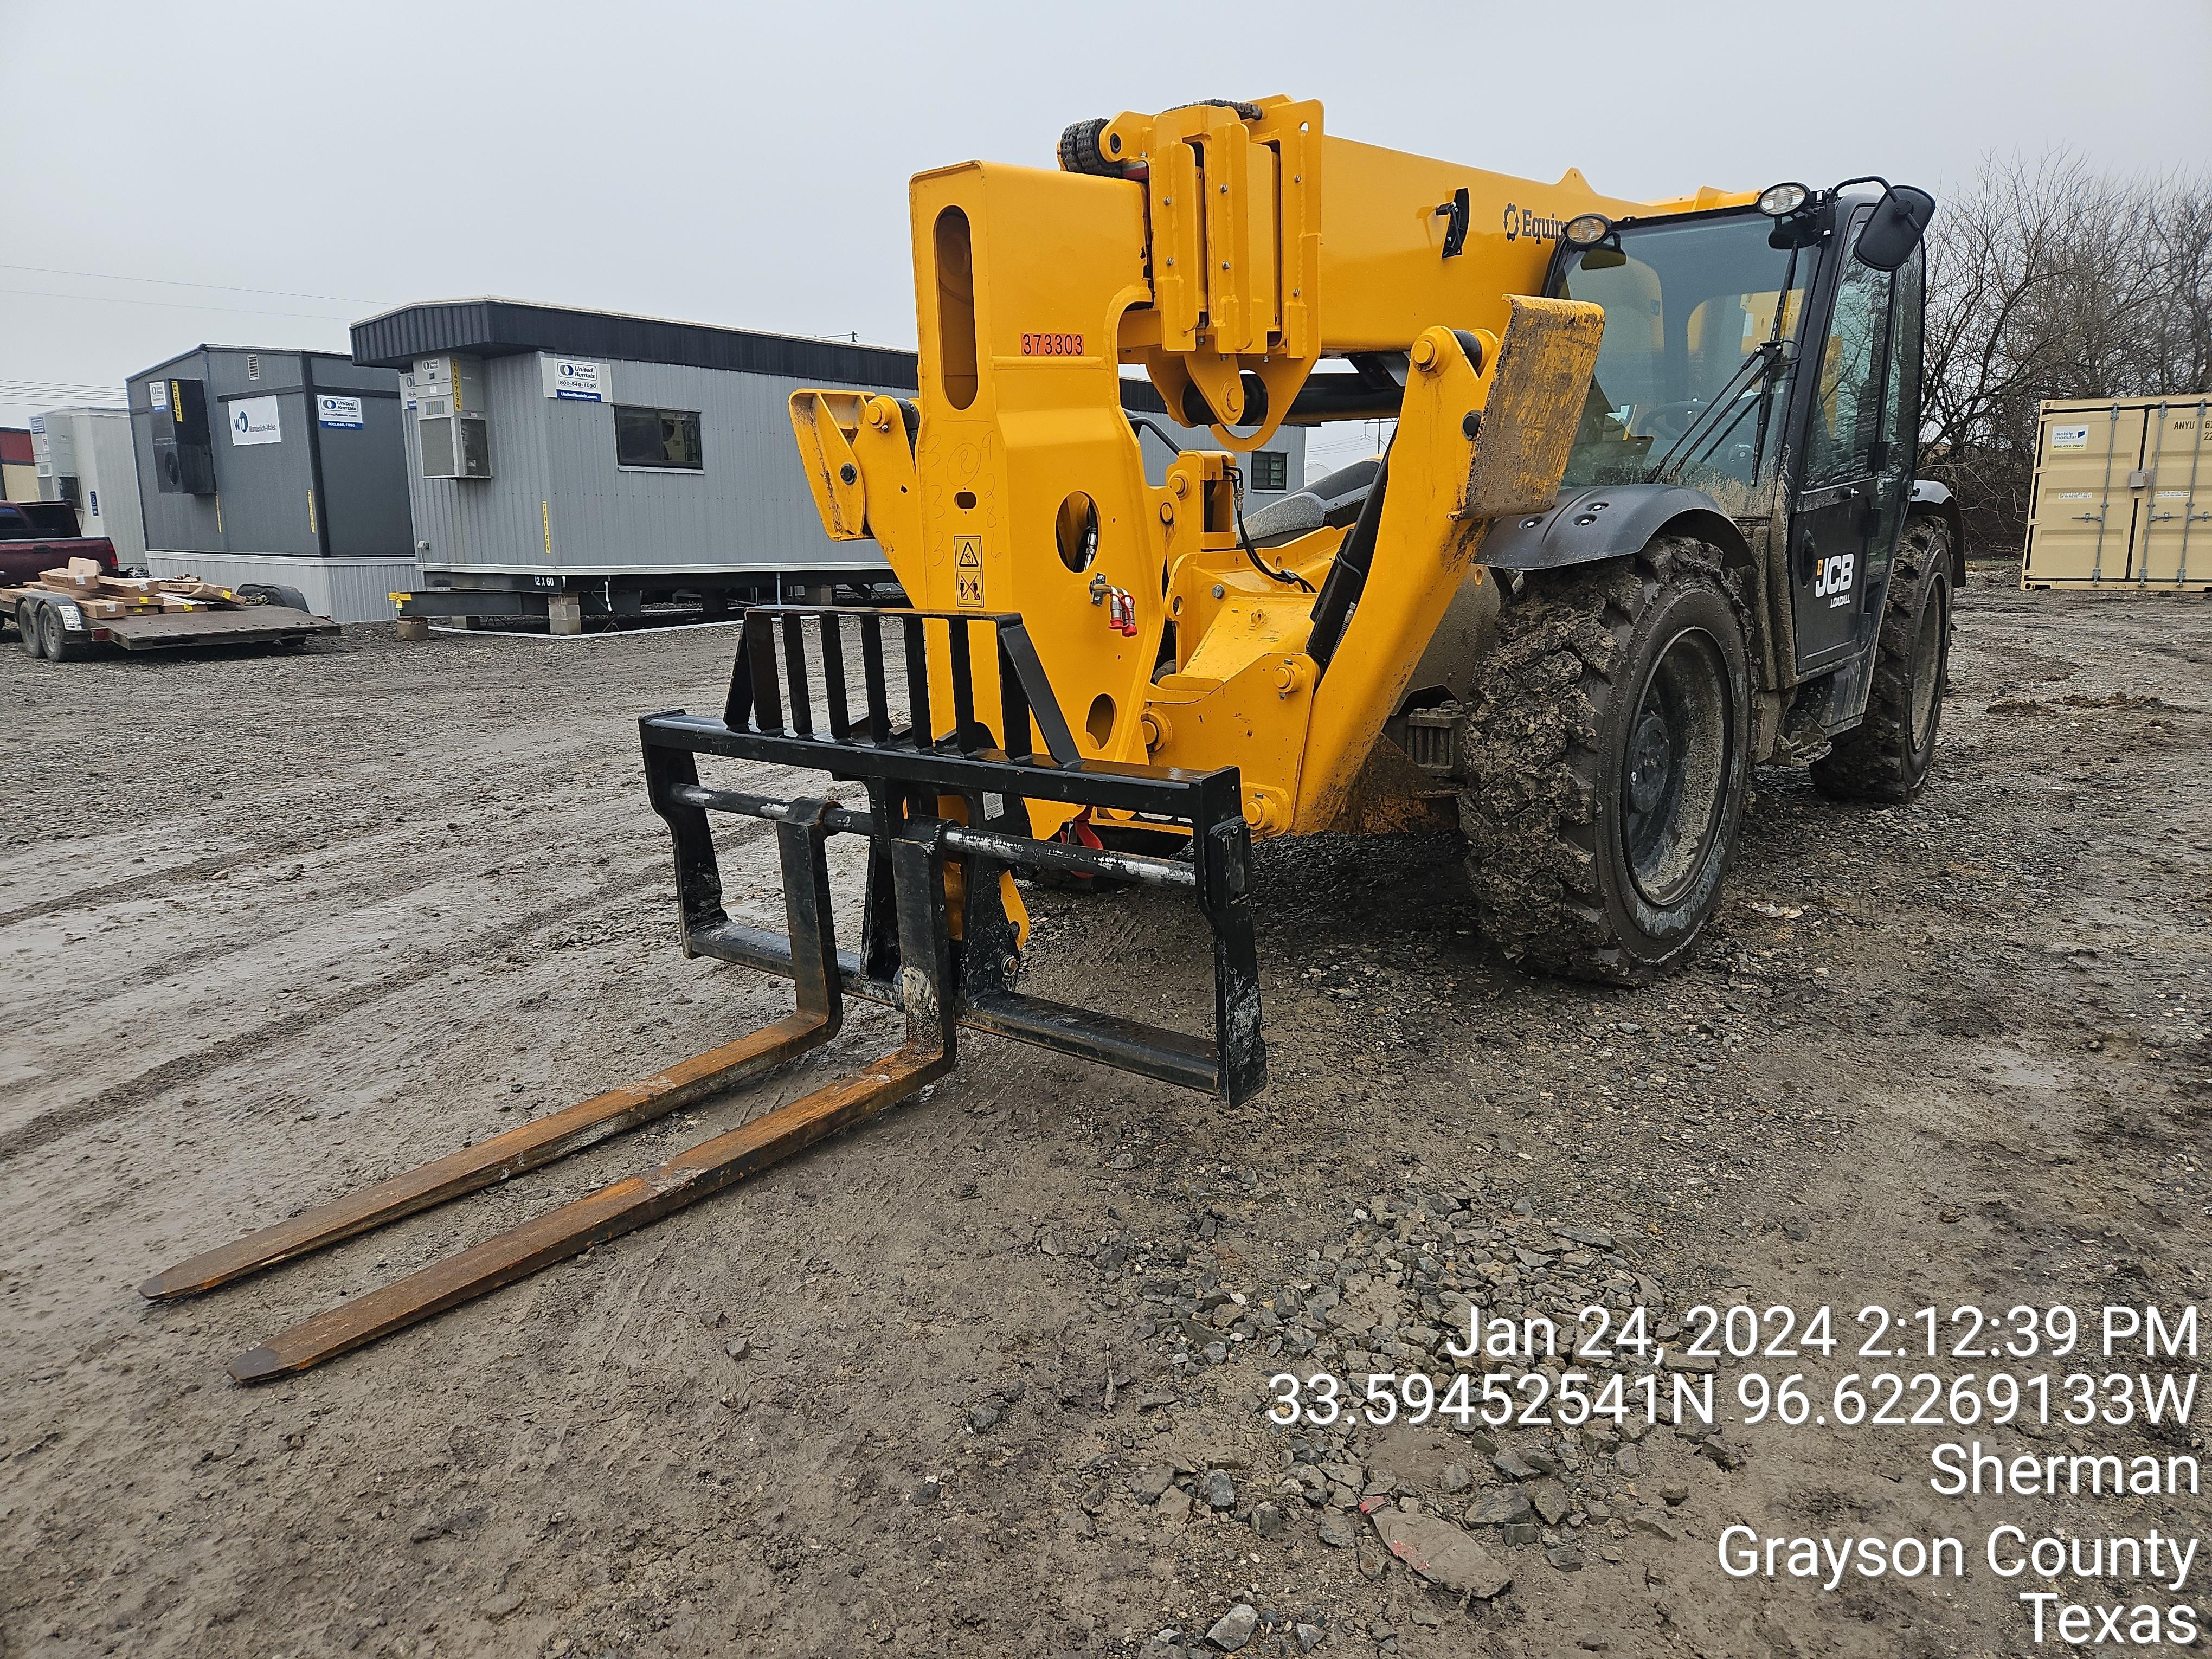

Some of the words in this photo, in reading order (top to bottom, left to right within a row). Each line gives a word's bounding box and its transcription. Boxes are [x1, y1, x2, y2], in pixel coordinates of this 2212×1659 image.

[1522, 209, 1568, 245] Equip
[1023, 333, 1083, 355] 373303
[560, 380, 596, 389] 800-546-1050
[2174, 421, 2195, 430] ANYU
[535, 576, 541, 586] 12
[541, 576, 545, 586] X
[546, 577, 554, 586] 60
[1815, 553, 1854, 597] JCB
[1830, 594, 1850, 608] LOADALL
